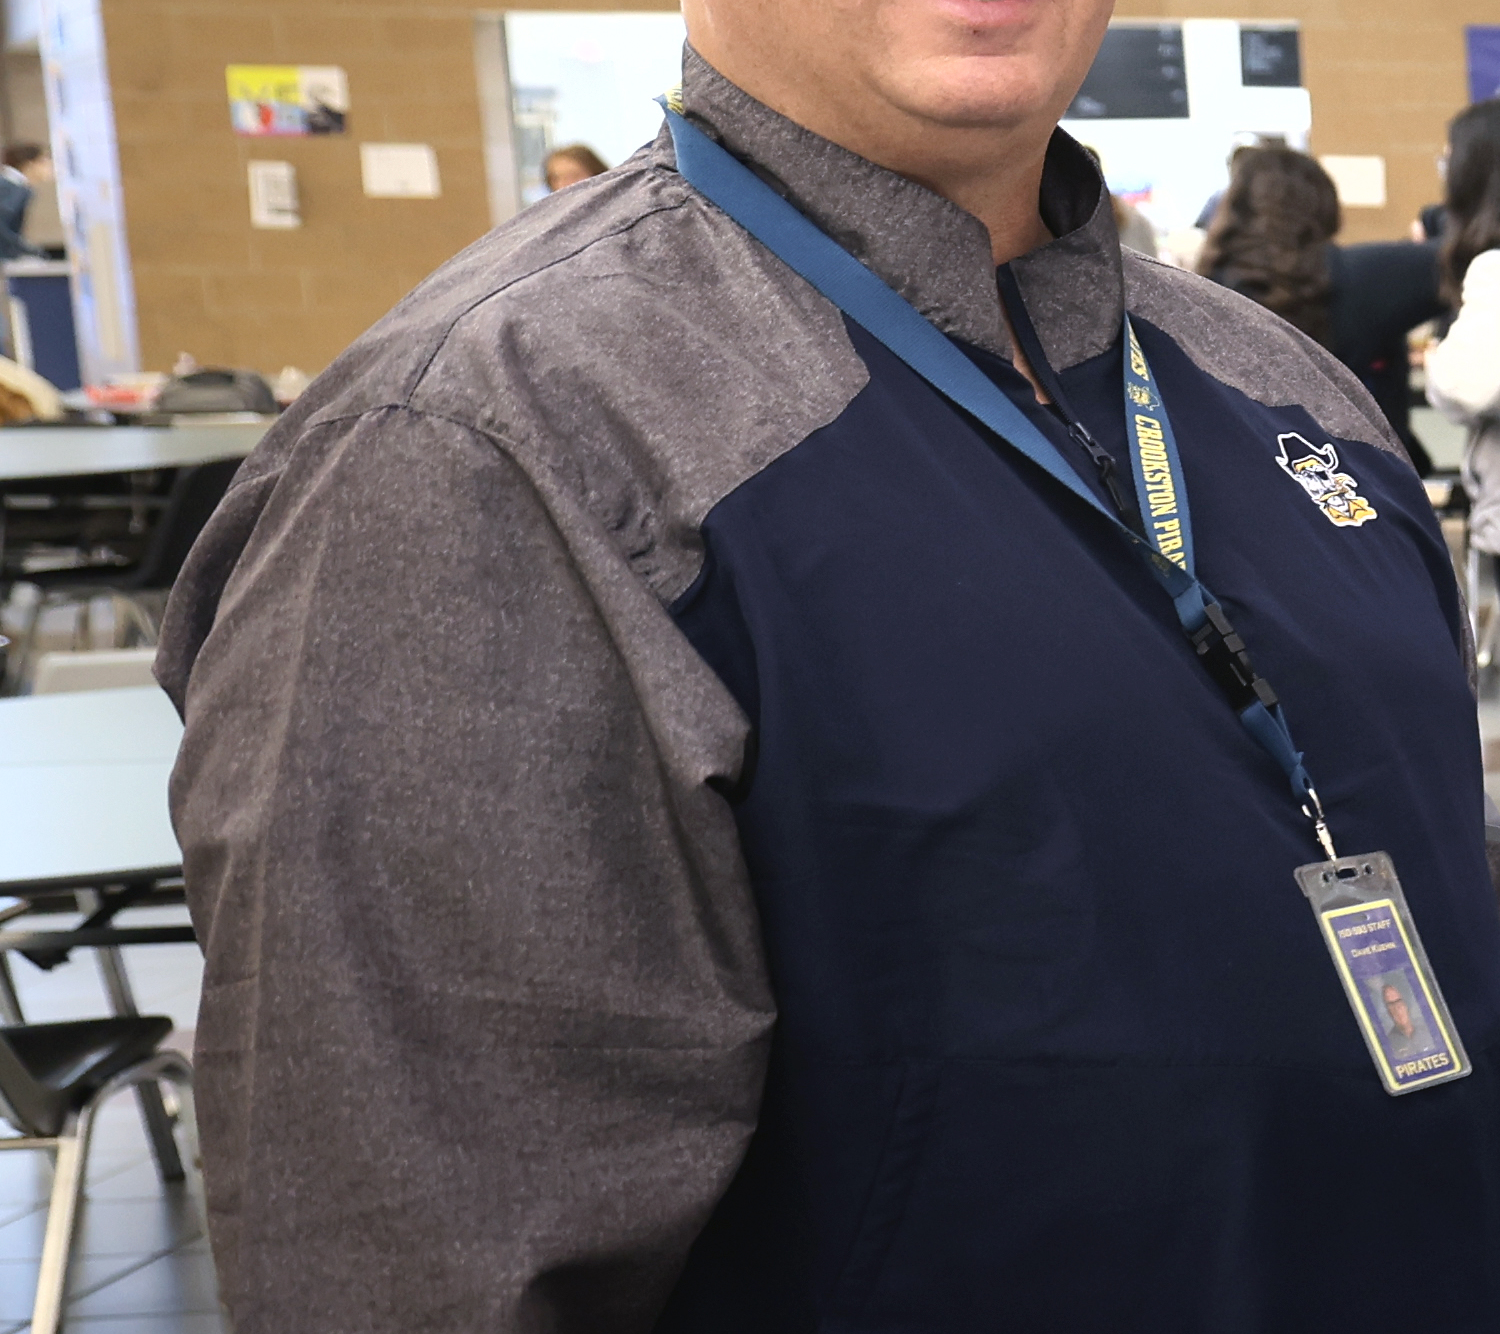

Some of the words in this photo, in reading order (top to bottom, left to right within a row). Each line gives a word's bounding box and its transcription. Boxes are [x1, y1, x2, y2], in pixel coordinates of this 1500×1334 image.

[1134, 413, 1179, 518] CROOKSTON
[1368, 918, 1392, 934] STAFF
[1394, 1052, 1450, 1079] PIRATES
